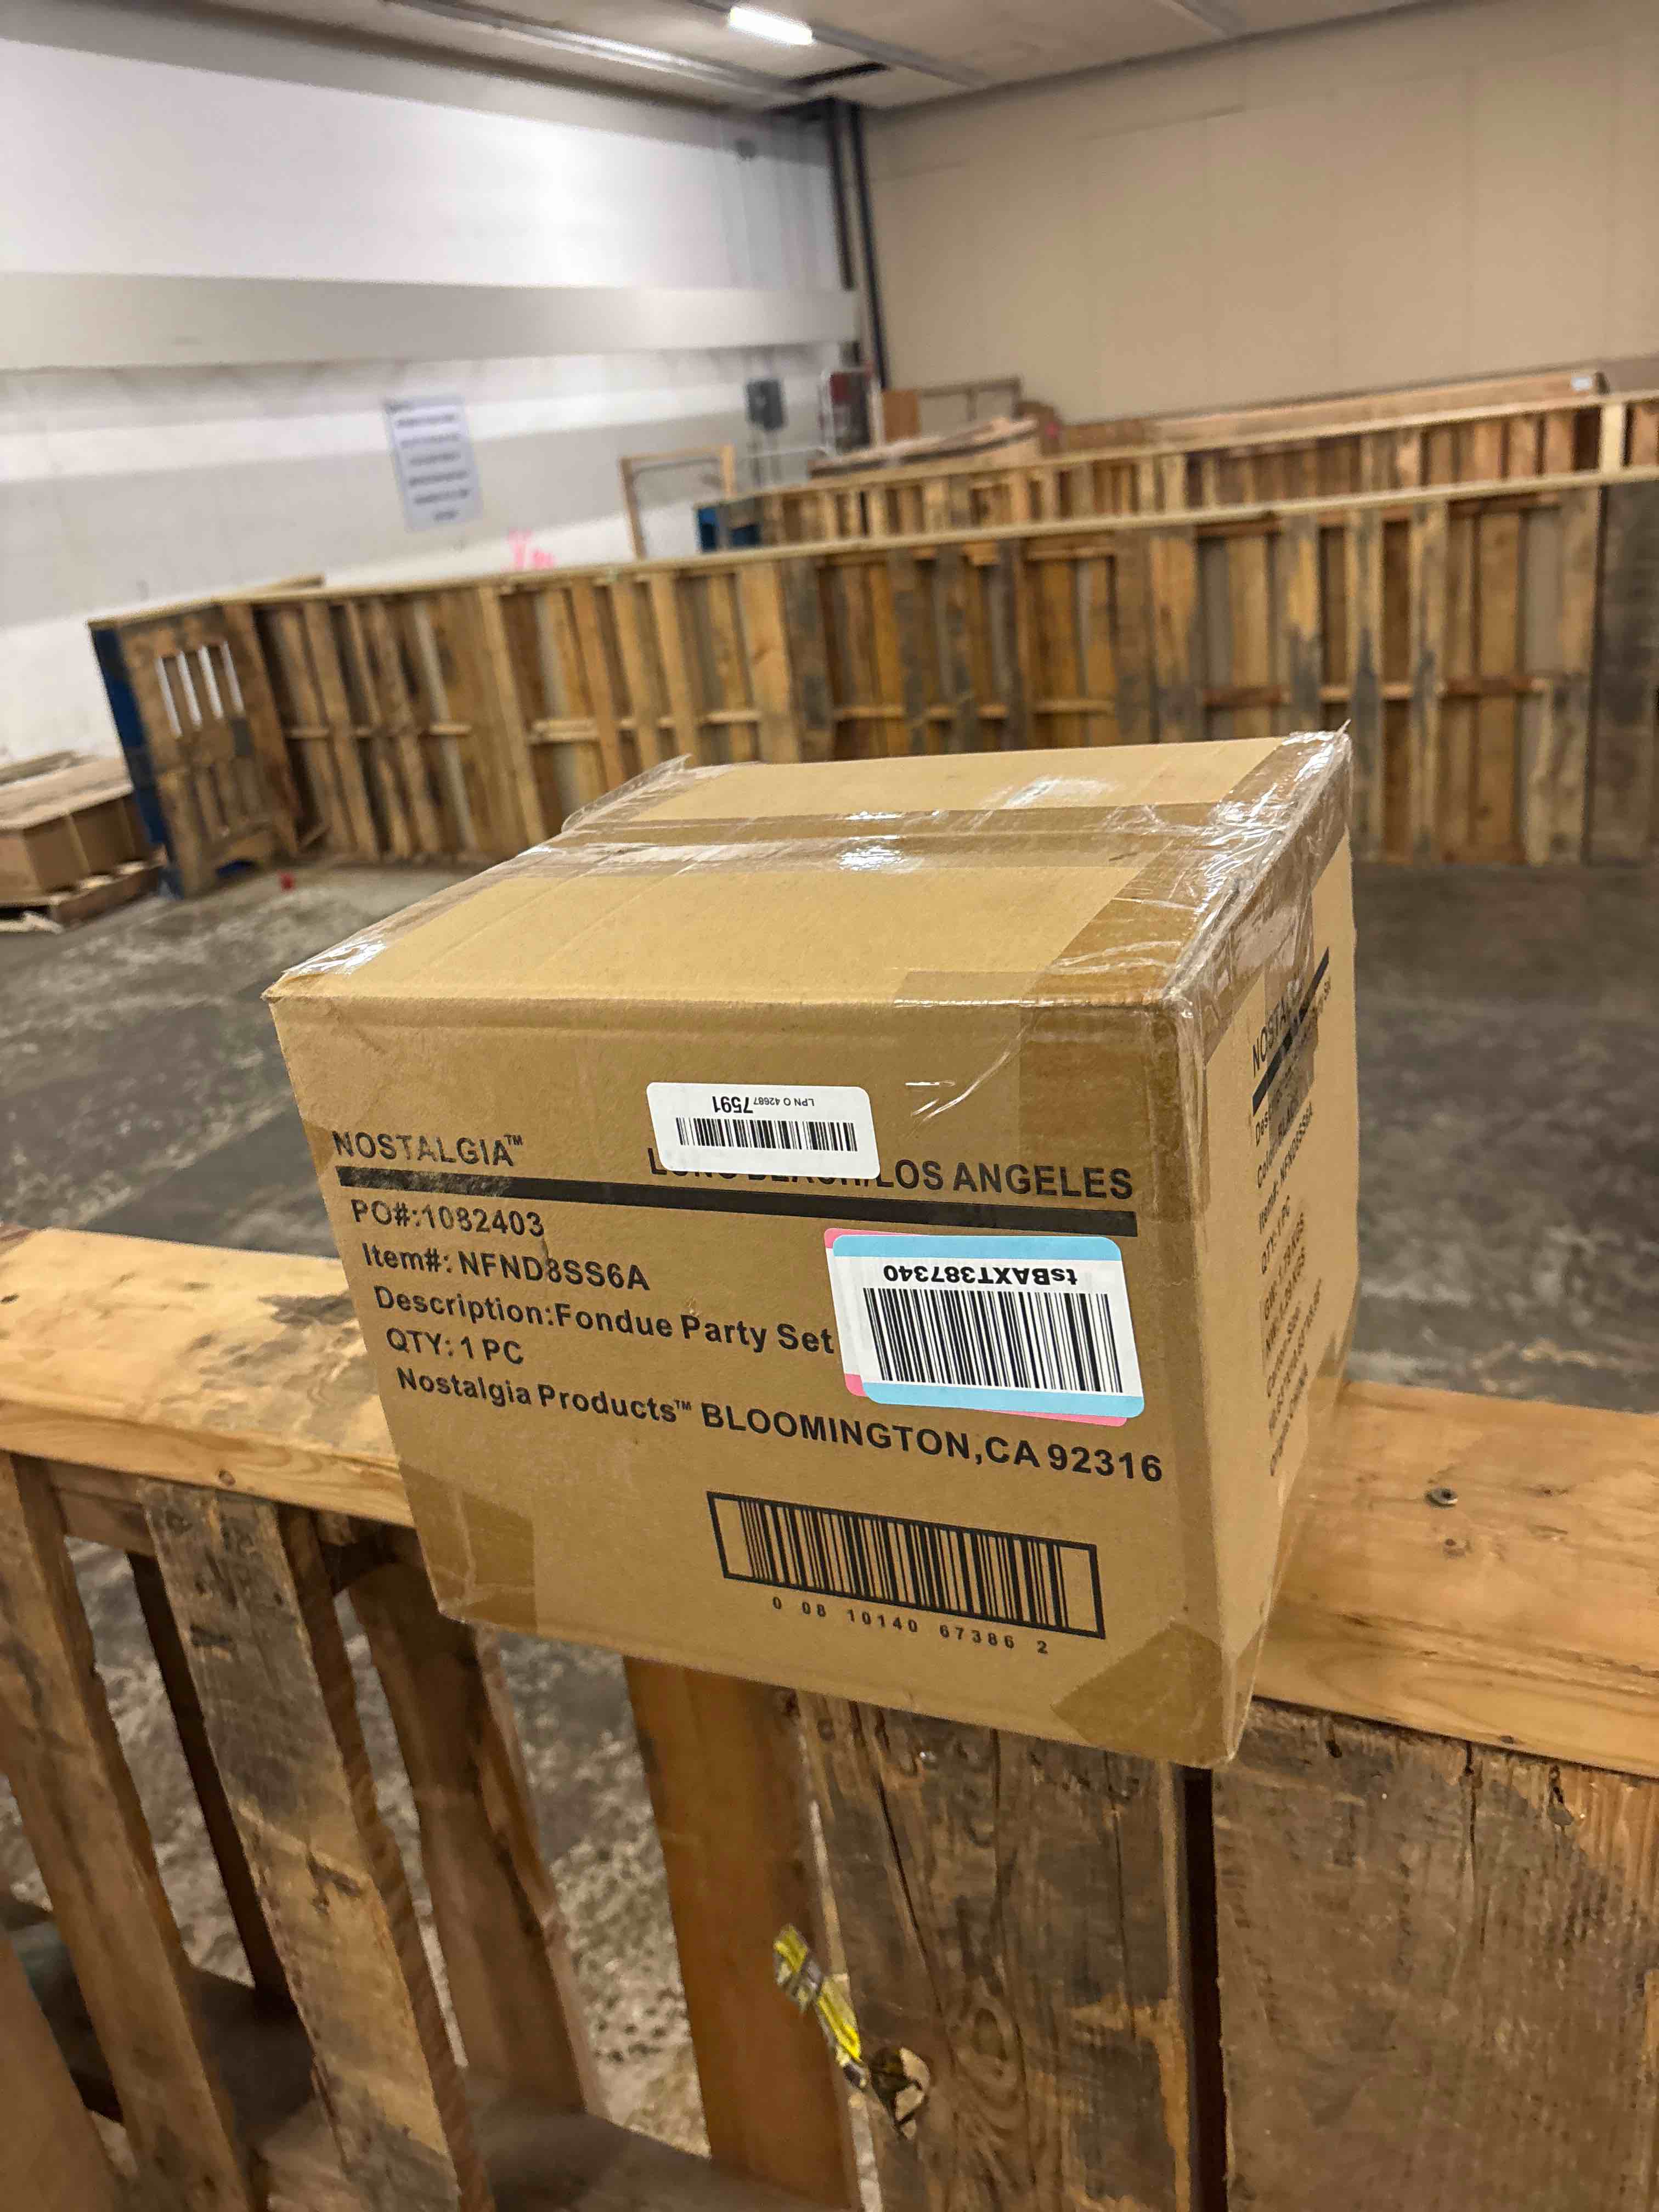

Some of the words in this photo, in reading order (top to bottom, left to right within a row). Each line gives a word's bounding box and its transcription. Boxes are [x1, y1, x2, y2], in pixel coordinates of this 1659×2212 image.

[794, 1098, 815, 1107] LPN
[953, 1162, 1133, 1200] ANGELES
[351, 1199, 544, 1237] PO#:1082403
[362, 1243, 452, 1274] Item#:
[458, 1250, 651, 1291] NFND8SS6A
[883, 1265, 1077, 1285] tsBAXT387340
[386, 1327, 454, 1357] QTY:
[460, 1335, 474, 1359] 1
[482, 1338, 524, 1365] PC
[682, 1315, 767, 1353] Party
[776, 1323, 834, 1354] Set
[396, 1367, 532, 1407] Nostalgia
[1047, 1443, 1163, 1483] 92316
[939, 1624, 1015, 1650] 67386
[1036, 1640, 1049, 1655] 2
